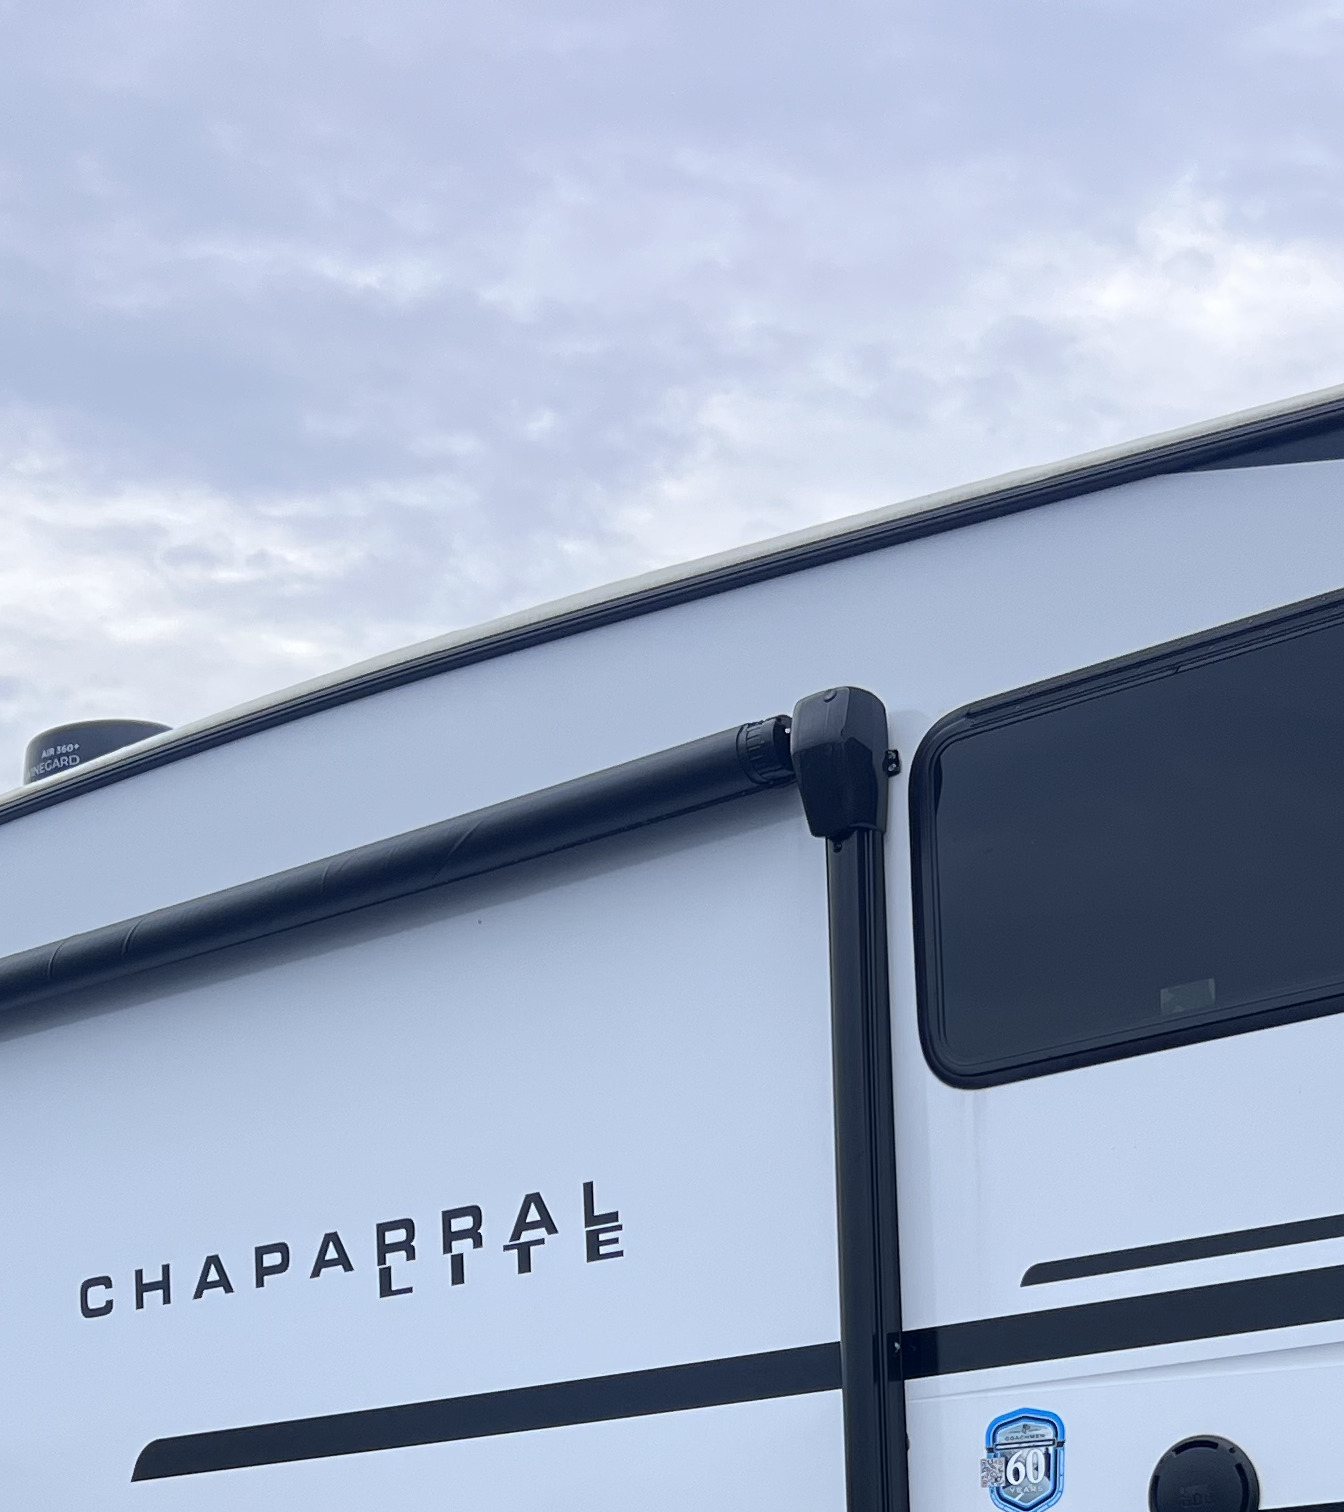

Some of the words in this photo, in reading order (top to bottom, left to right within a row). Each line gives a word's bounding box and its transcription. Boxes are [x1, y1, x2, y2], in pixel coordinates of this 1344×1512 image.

[41, 747, 55, 758] AIR
[56, 743, 80, 755] 360+
[80, 1180, 619, 1318] CHAPARRAL
[379, 1224, 624, 1298] LITE
[1005, 1433, 1046, 1442] COACHMEN
[1006, 1448, 1045, 1485] 60
